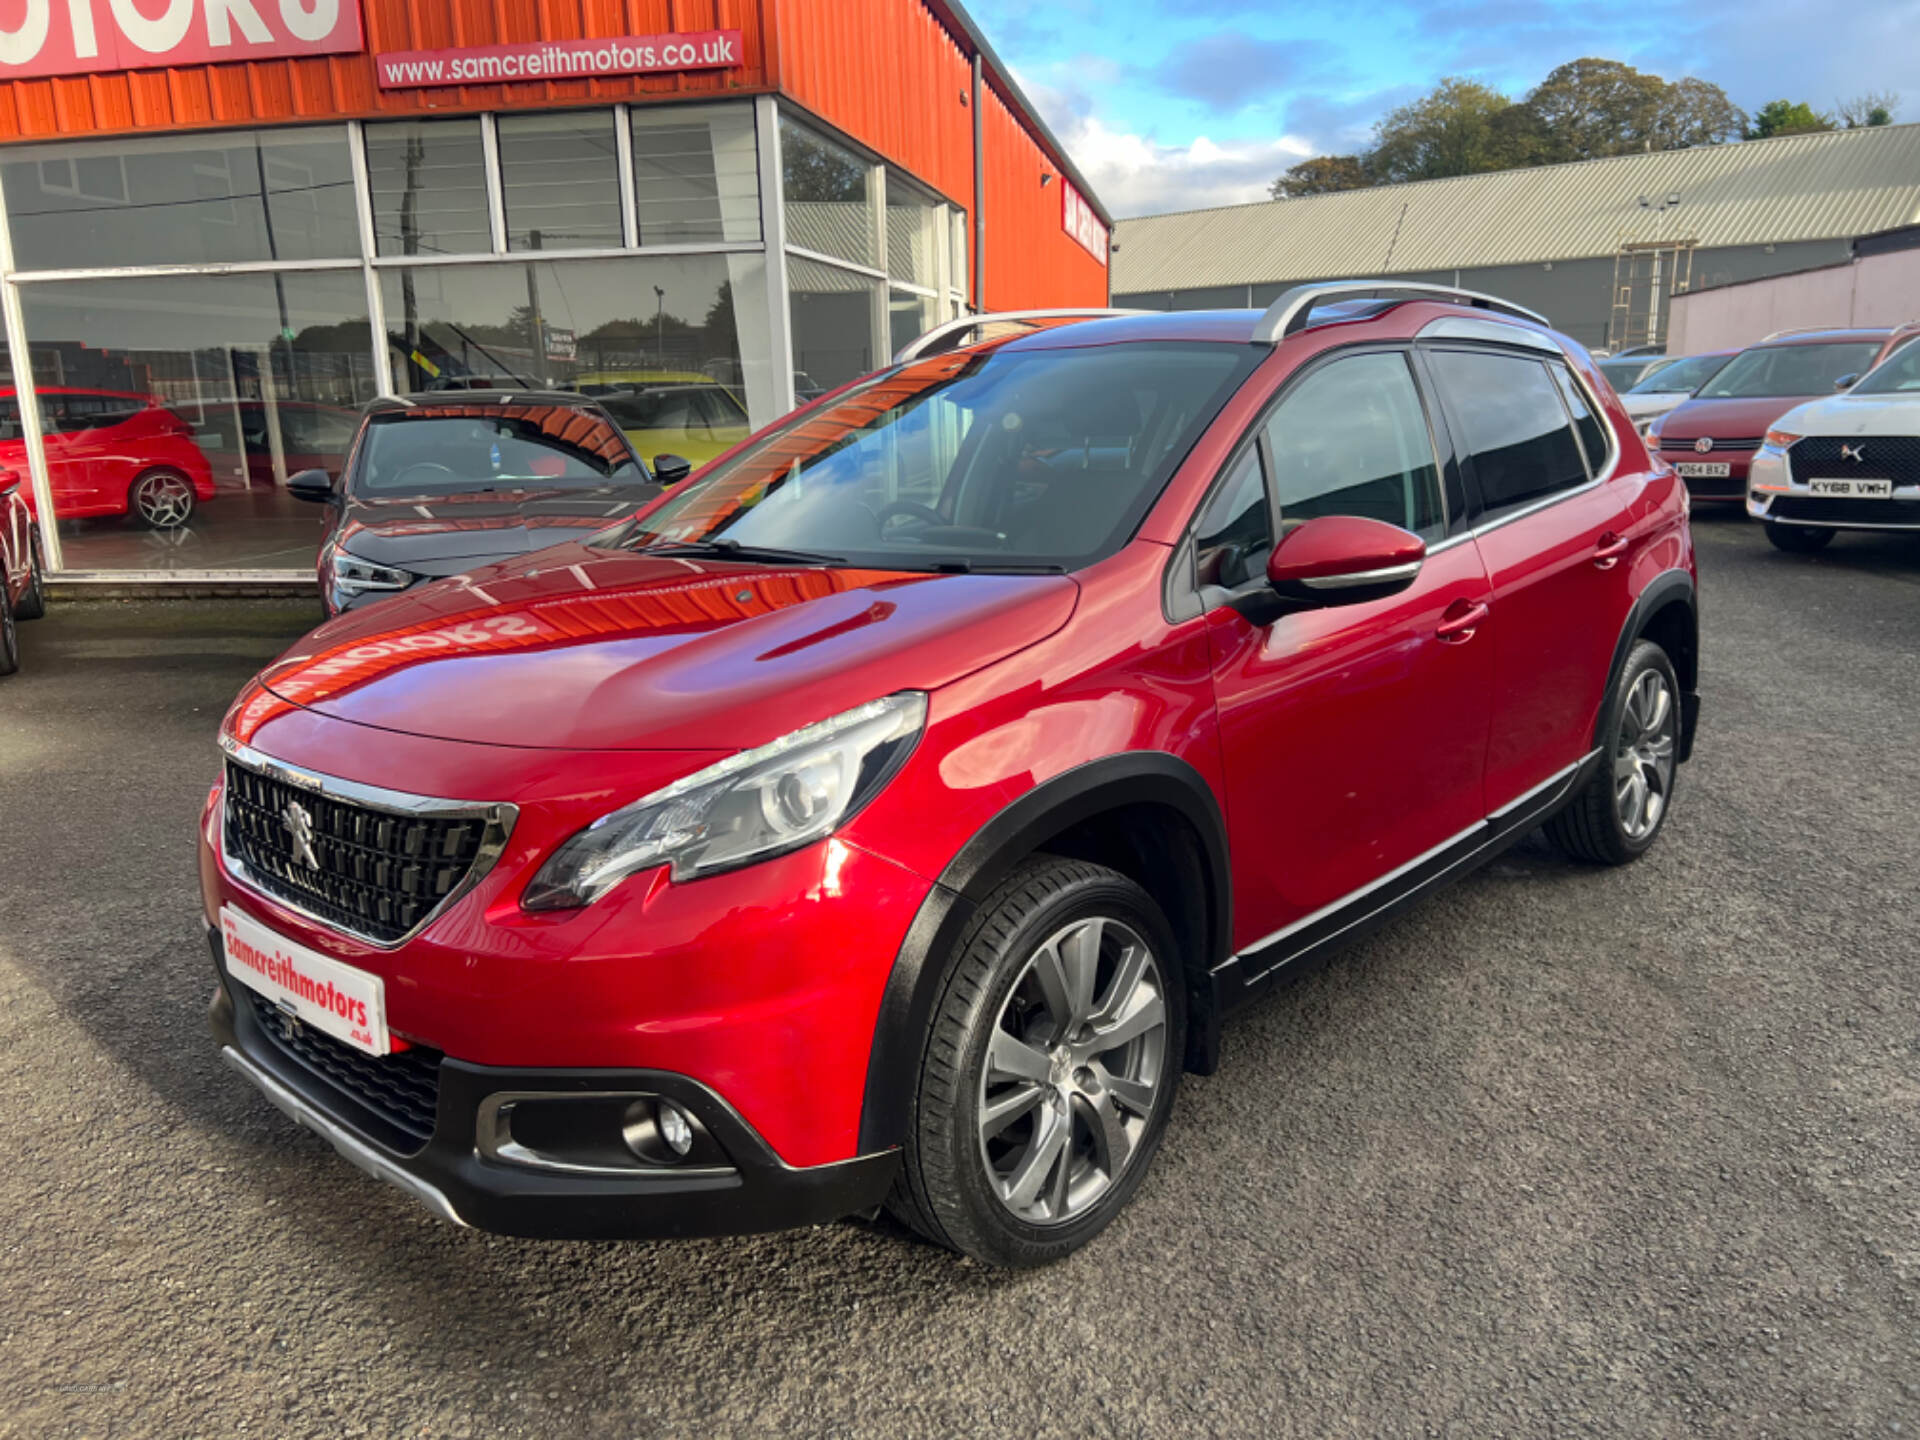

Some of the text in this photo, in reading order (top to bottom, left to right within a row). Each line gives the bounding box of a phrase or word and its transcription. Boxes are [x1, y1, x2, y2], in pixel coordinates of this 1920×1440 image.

[385, 36, 734, 83] www.samcreithmotors.co.uk
[1857, 482, 1887, 494] VWH
[226, 932, 367, 1027] samcreithmotors
